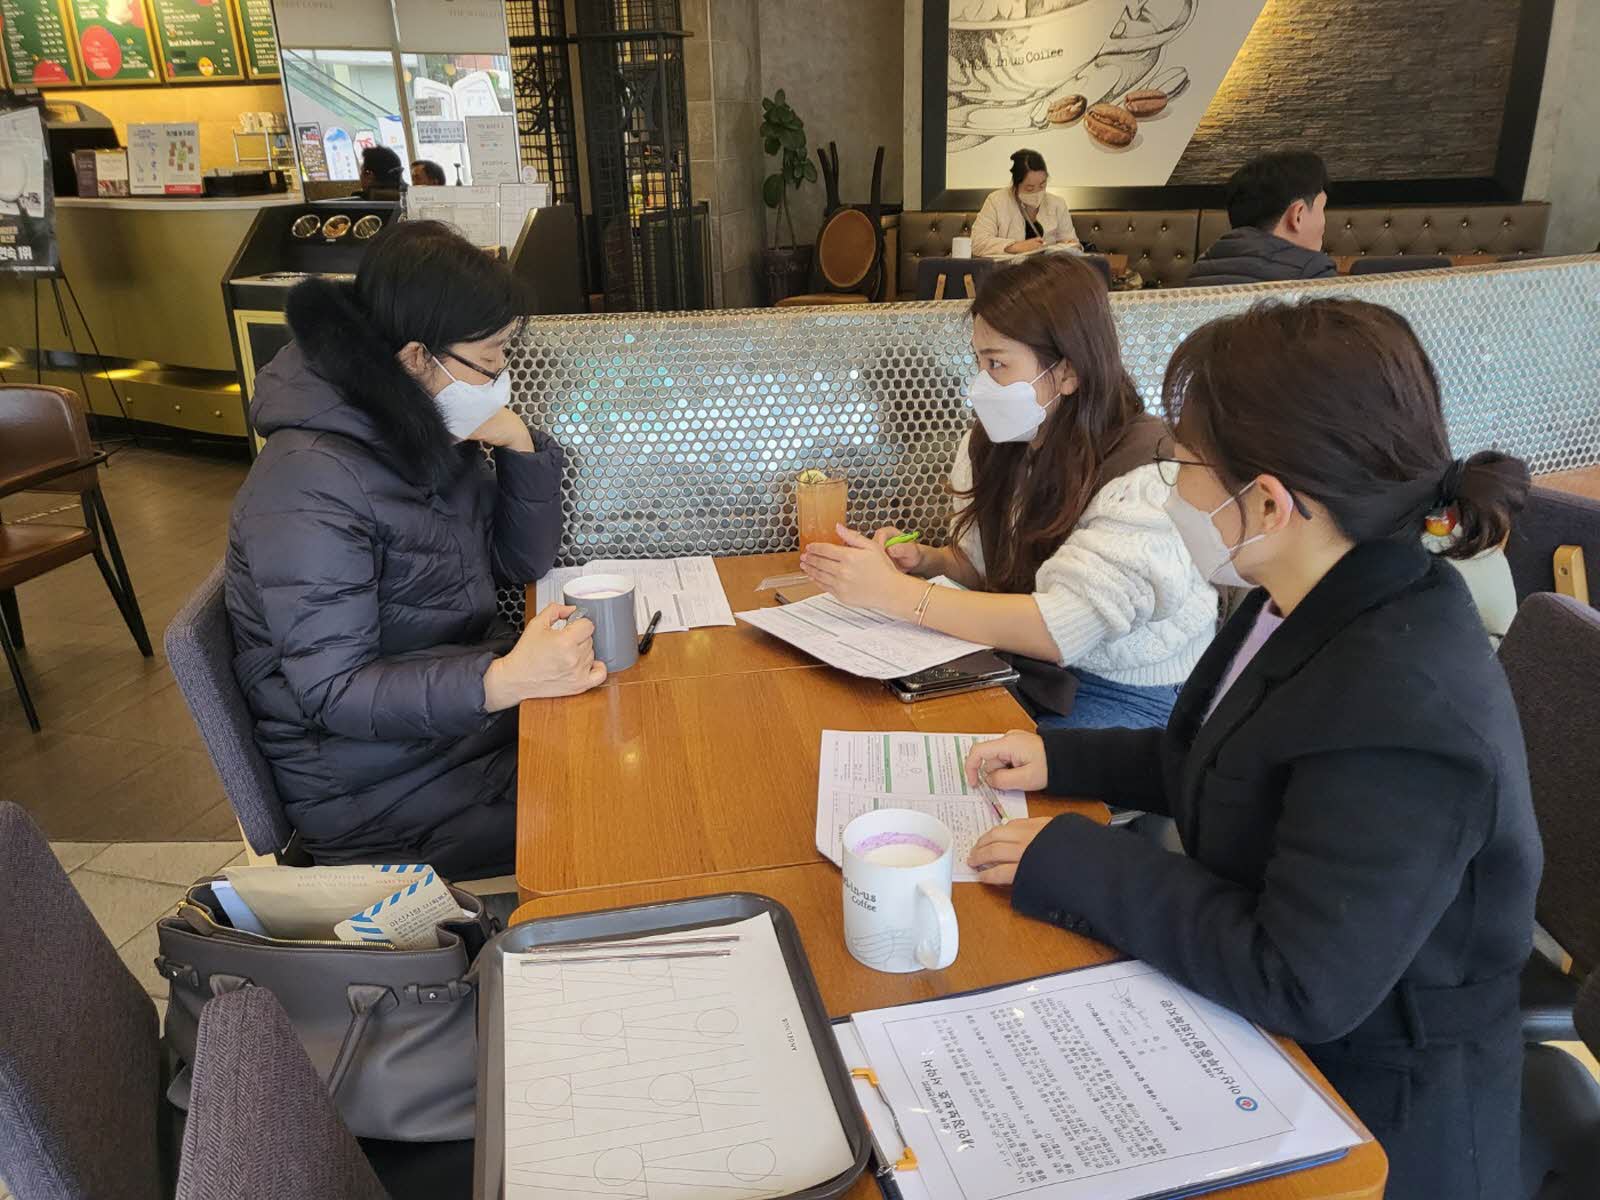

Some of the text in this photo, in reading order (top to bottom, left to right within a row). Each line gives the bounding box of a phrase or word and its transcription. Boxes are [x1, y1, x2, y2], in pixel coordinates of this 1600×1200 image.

[920, 1058, 944, 1085] 서약서
[1157, 997, 1245, 1096] 아산서부종합사회복지관
[936, 1089, 977, 1150] 개인정보보호
